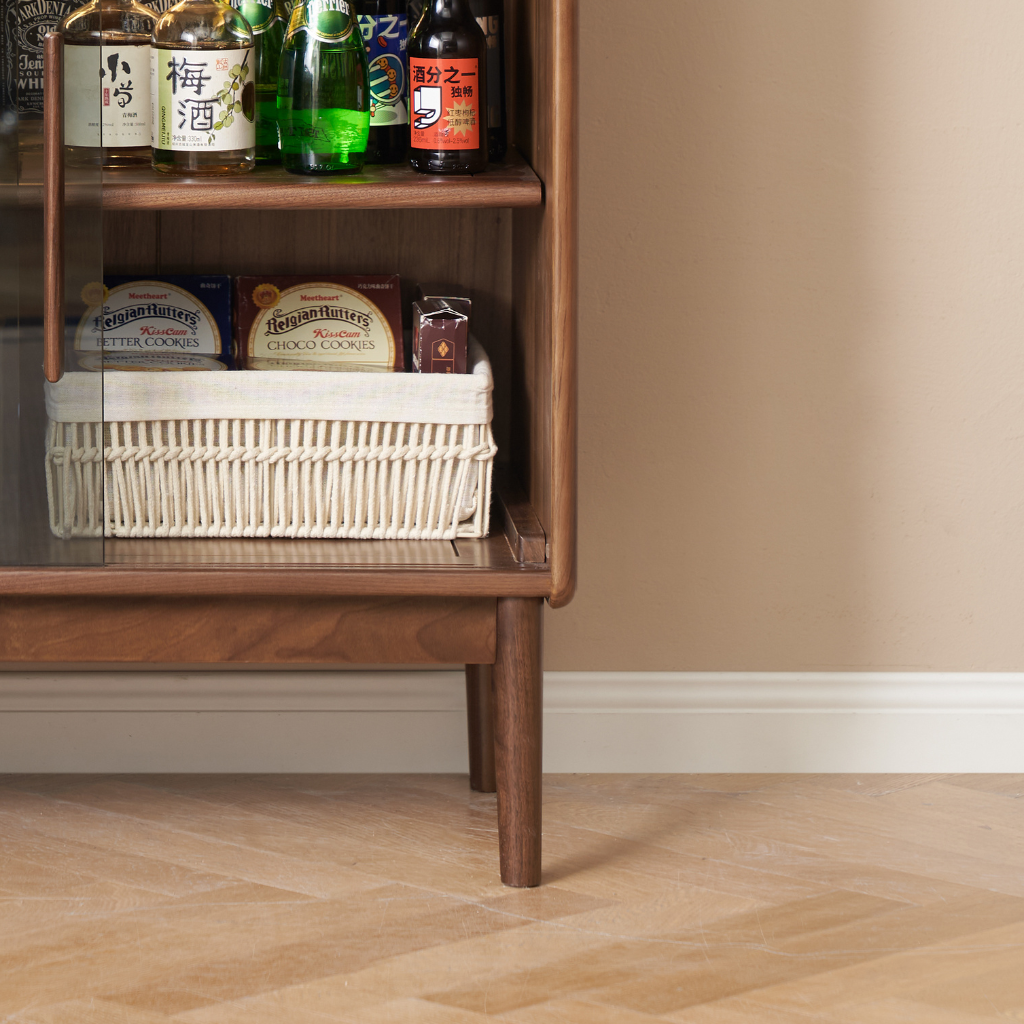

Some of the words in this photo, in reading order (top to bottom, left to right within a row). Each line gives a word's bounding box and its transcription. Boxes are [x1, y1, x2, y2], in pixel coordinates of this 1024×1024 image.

[357, 14, 407, 40] 分之一
[413, 66, 476, 84] 酒分之一
[13, 78, 44, 89] WHI
[166, 56, 219, 131] 梅酒
[451, 86, 473, 98] 独畅
[96, 338, 144, 348] BETTER
[145, 338, 199, 349] COOKIES
[267, 340, 316, 350] CHOCO
[321, 340, 375, 351] COOKIES
